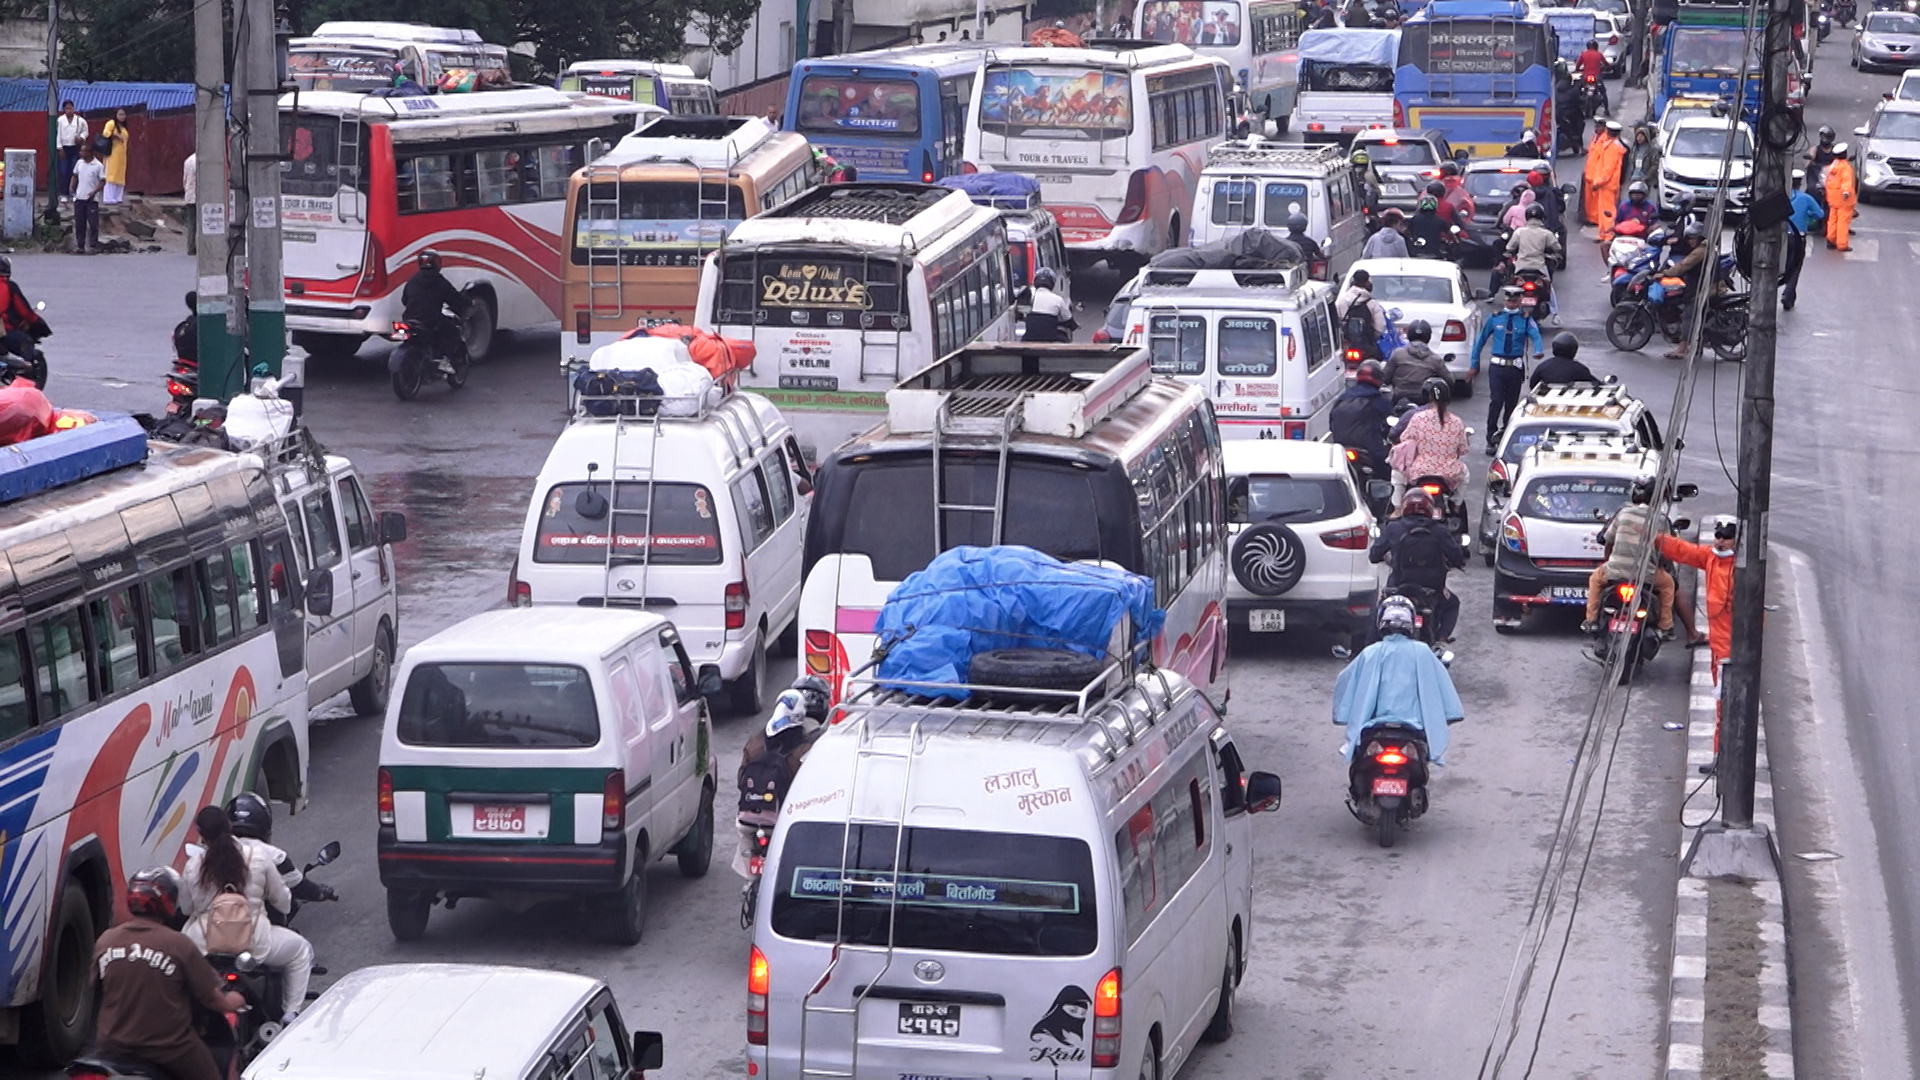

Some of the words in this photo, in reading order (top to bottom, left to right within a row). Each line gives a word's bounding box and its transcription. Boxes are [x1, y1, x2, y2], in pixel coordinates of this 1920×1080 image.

[1019, 153, 1041, 162] TOUR
[1052, 155, 1088, 165] TRAVELS
[1224, 319, 1270, 331] जनकपुर
[799, 359, 831, 368] KELME
[1016, 786, 1072, 816] मुस्कान
